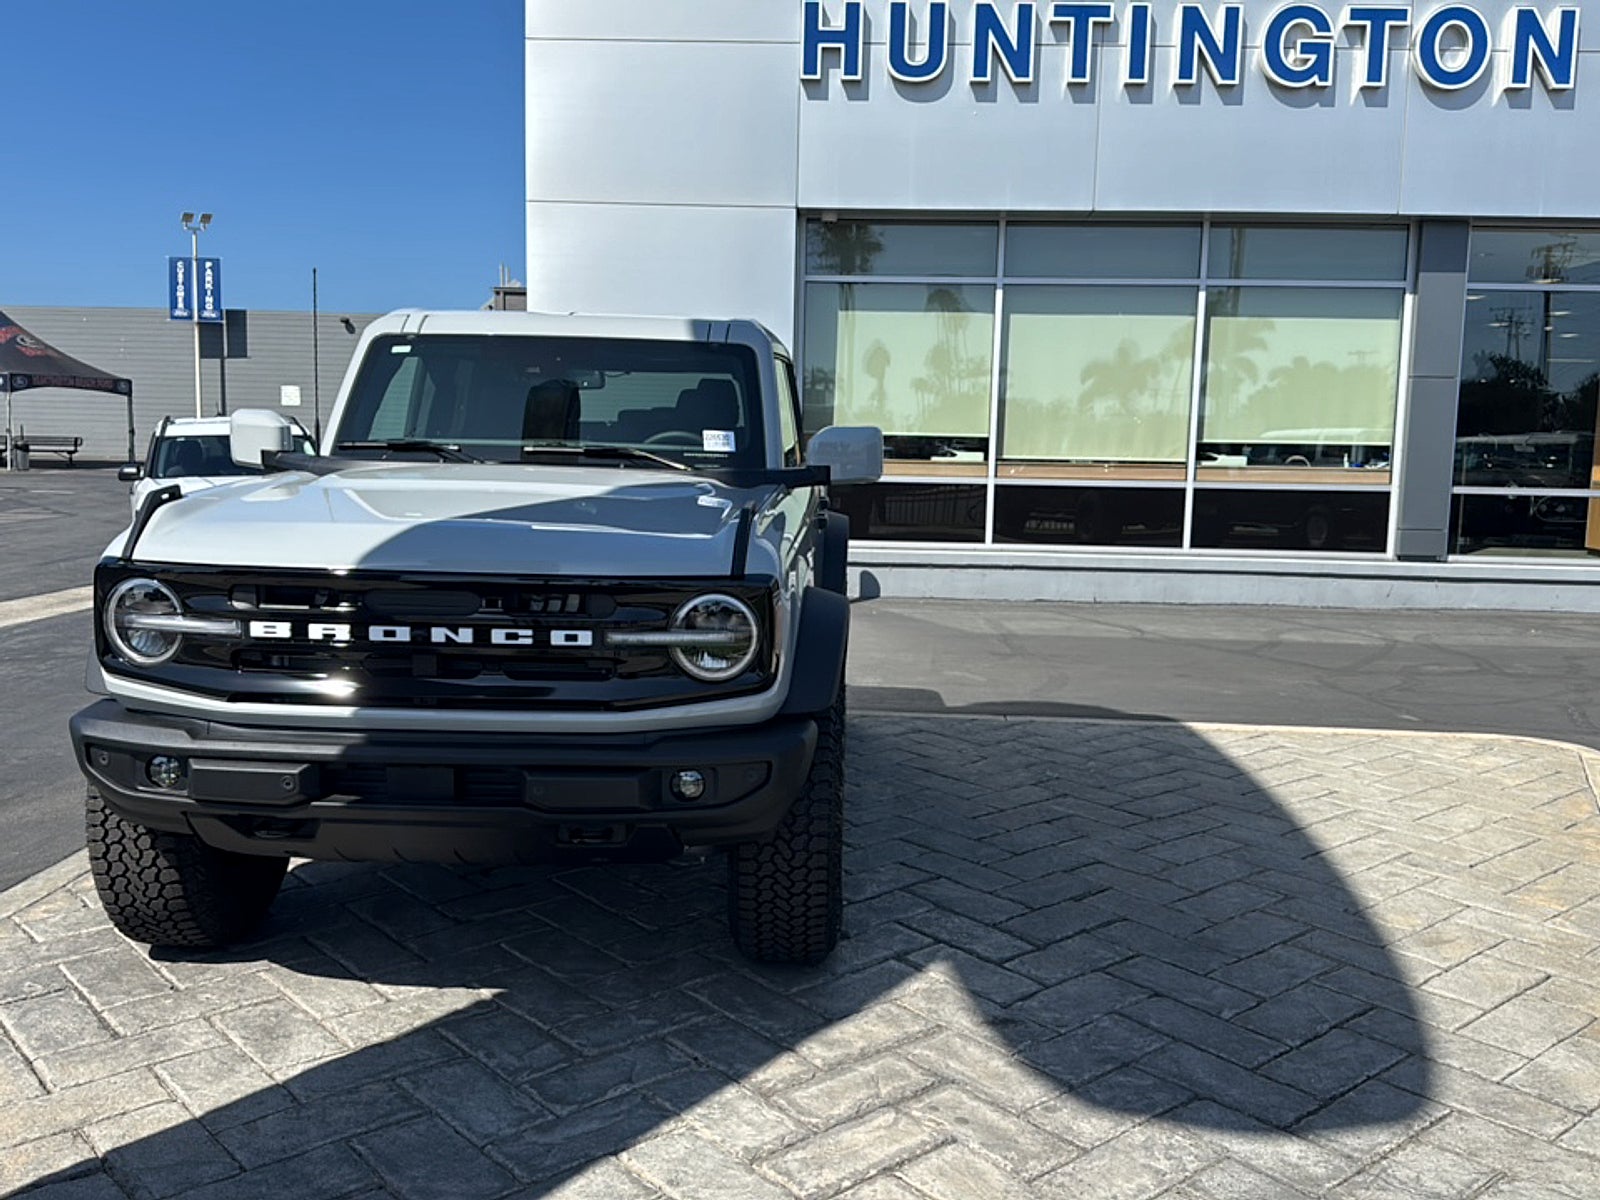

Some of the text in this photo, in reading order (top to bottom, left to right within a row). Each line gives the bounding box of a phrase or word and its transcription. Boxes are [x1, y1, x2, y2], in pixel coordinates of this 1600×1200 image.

[800, 0, 1581, 90] HUNTINGTON
[176, 260, 185, 310] CUSTOMER
[204, 261, 214, 310] PARKING
[249, 620, 593, 647] BRONCO
